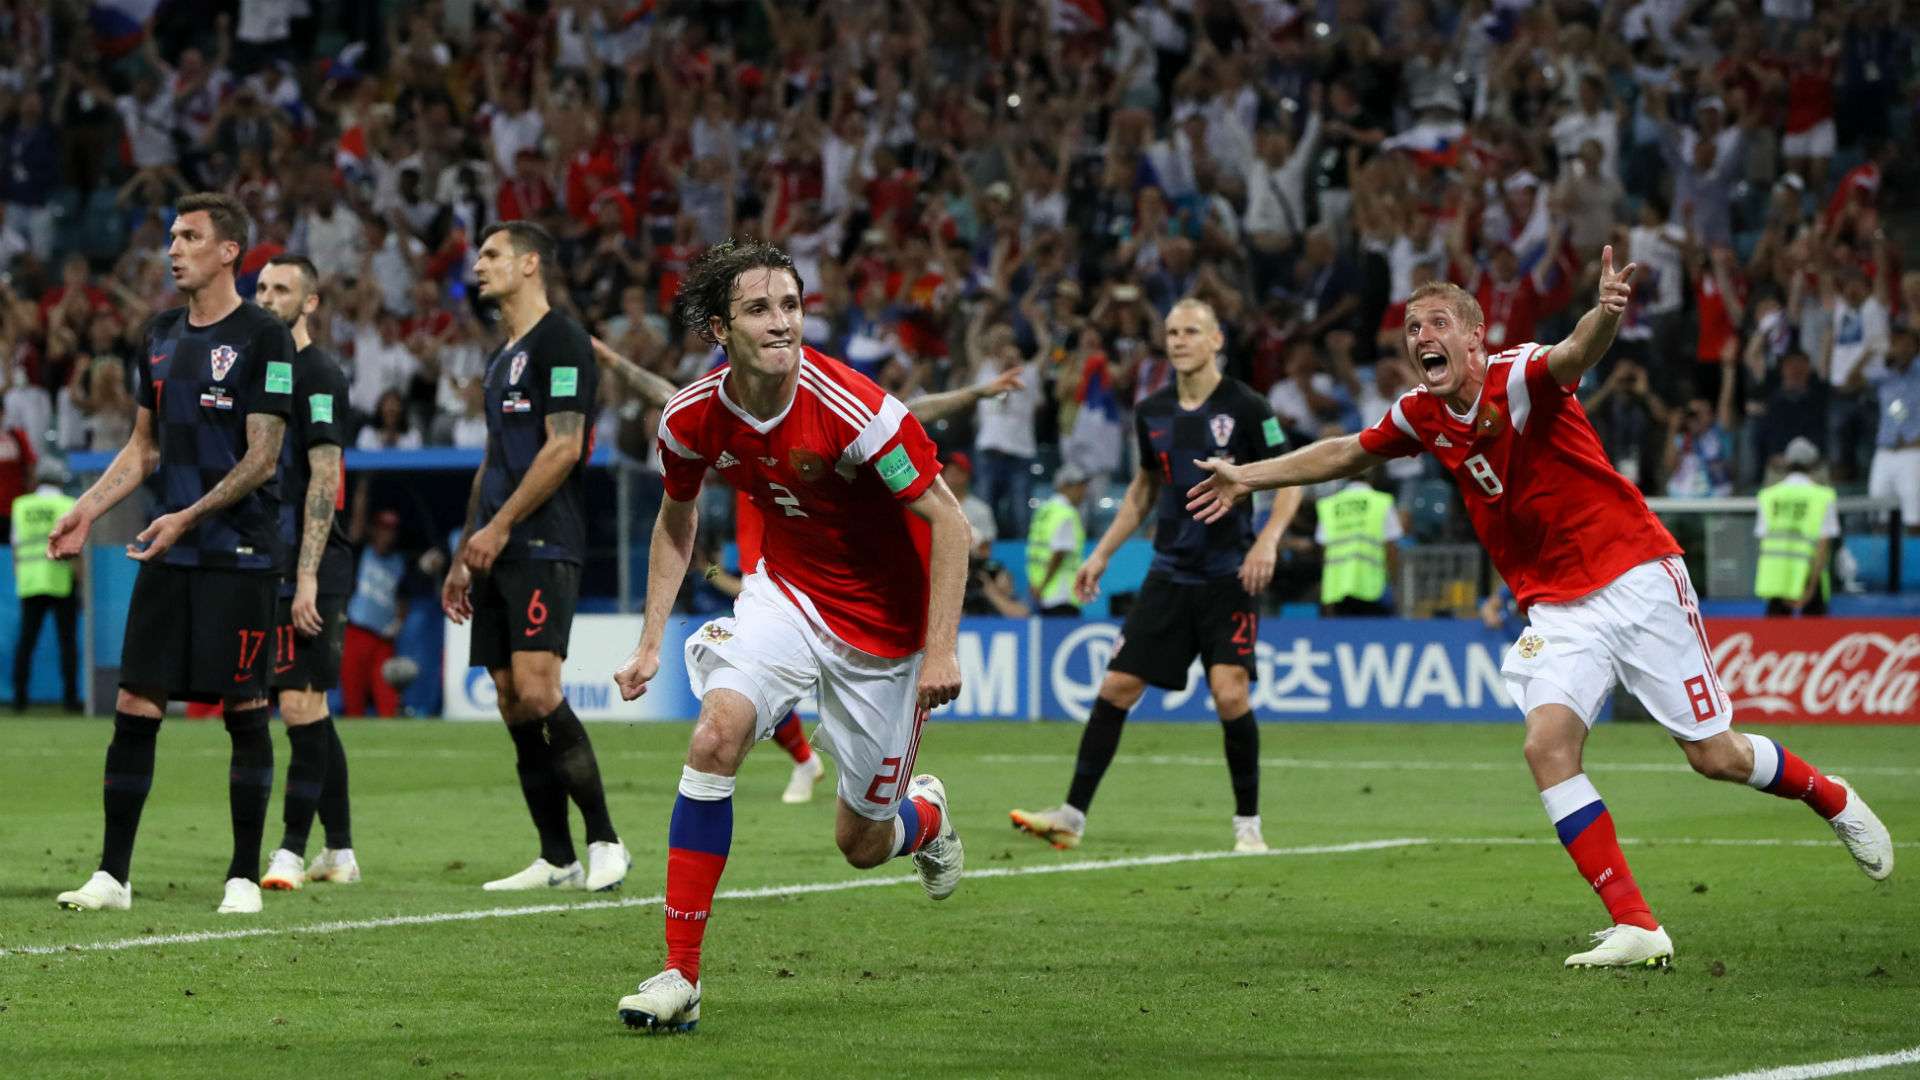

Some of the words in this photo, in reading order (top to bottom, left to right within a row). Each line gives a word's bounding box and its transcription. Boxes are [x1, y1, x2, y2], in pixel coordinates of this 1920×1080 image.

[1464, 453, 1504, 496] 8
[768, 482, 809, 518] 2
[527, 589, 548, 625] 6
[1231, 612, 1257, 643] 21
[239, 630, 265, 669] 17
[1712, 632, 1920, 715] Coca-Cola
[1683, 674, 1717, 724] 8
[864, 757, 901, 805] 2
